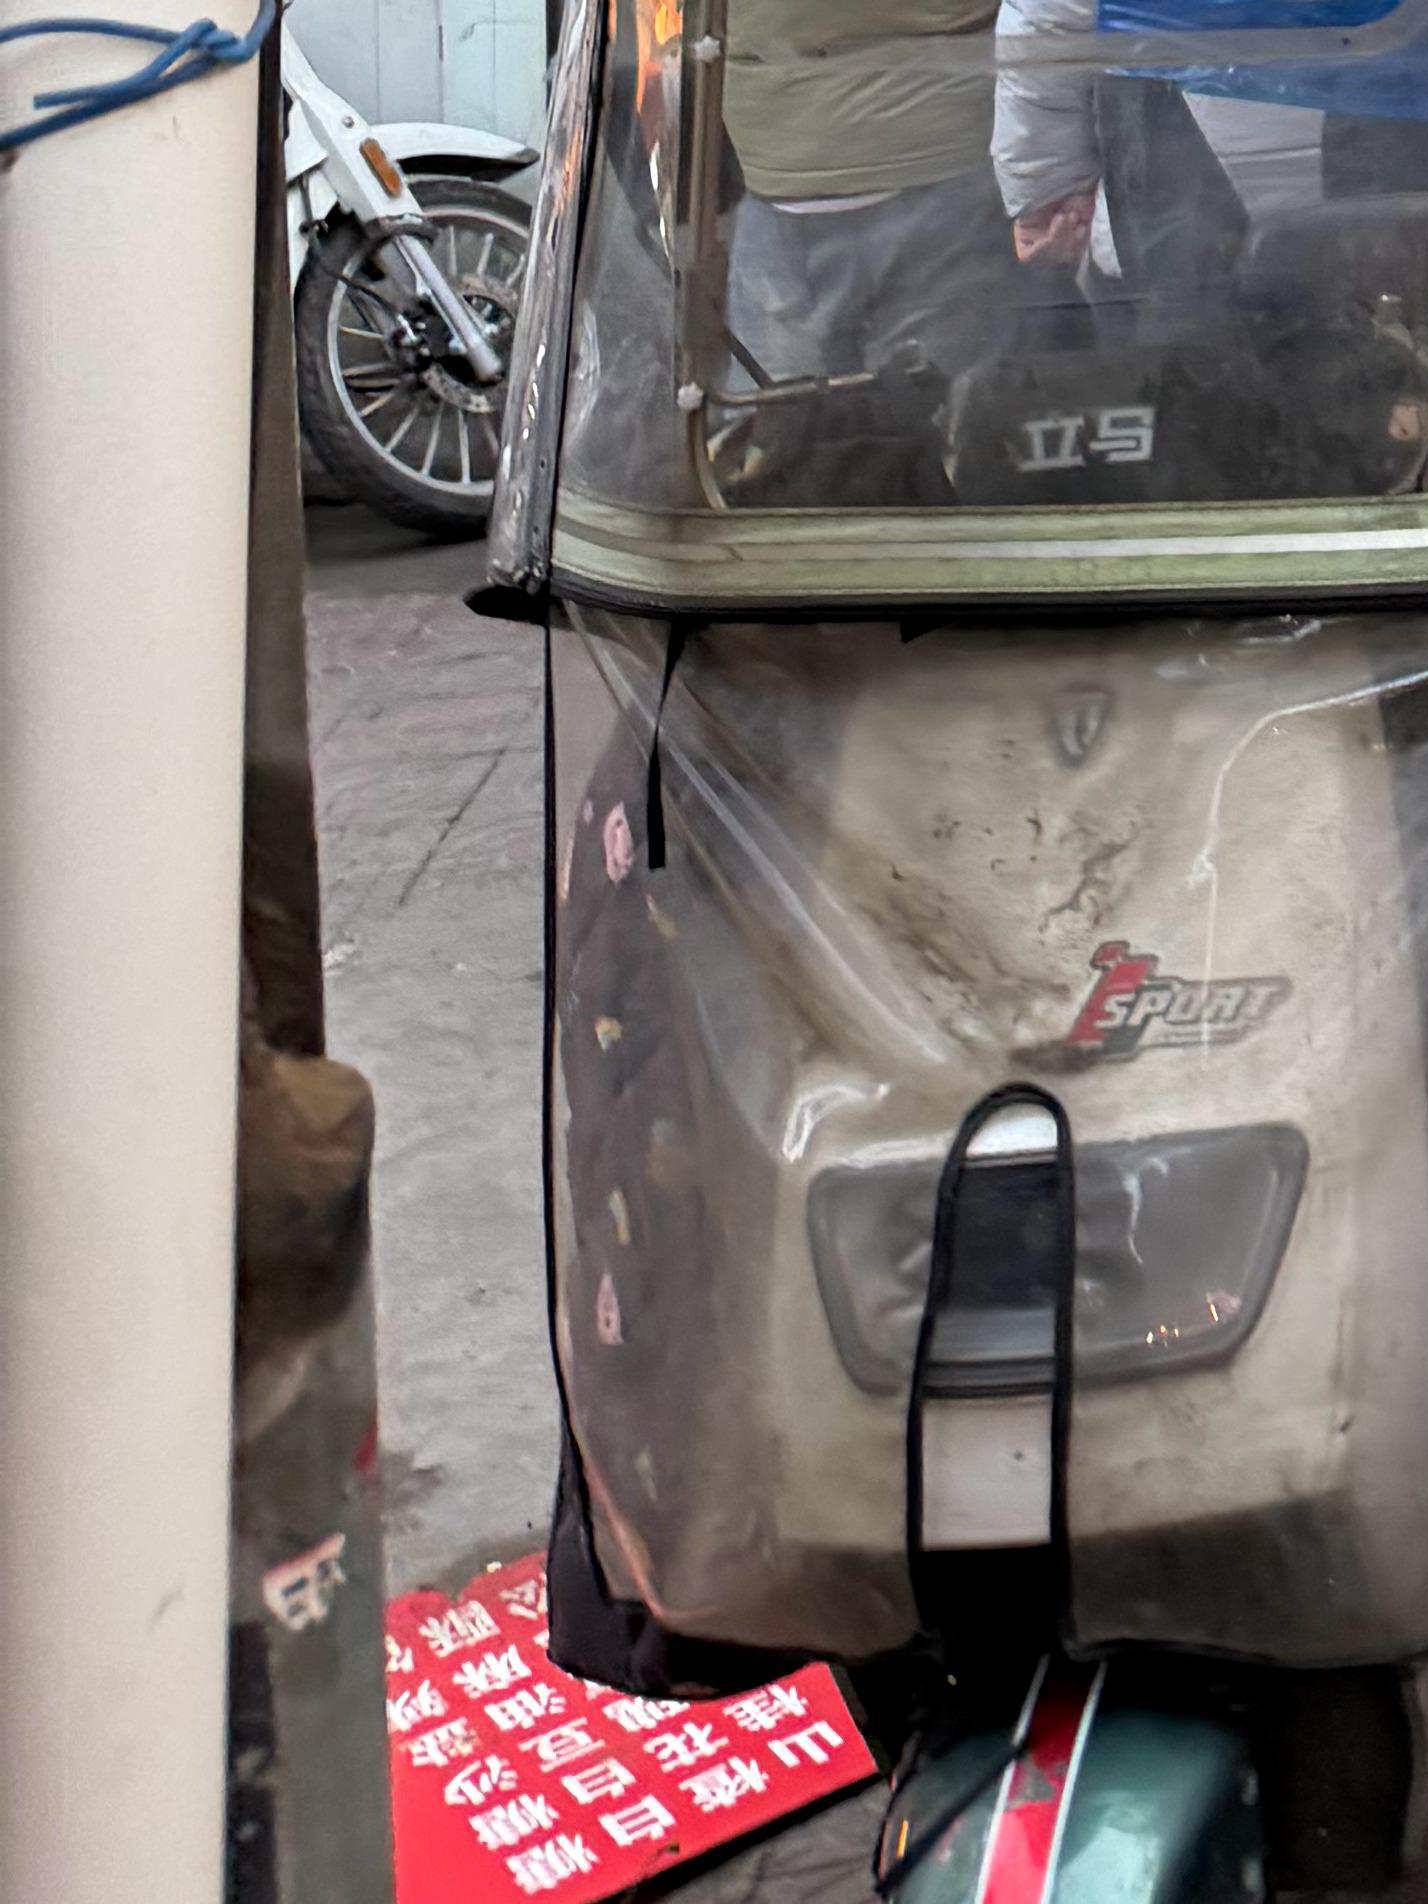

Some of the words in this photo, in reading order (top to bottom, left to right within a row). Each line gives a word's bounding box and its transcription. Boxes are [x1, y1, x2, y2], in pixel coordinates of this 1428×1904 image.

[468, 1684, 809, 1851] 桂花白糖
[504, 1721, 844, 1896] 山楂白糖
